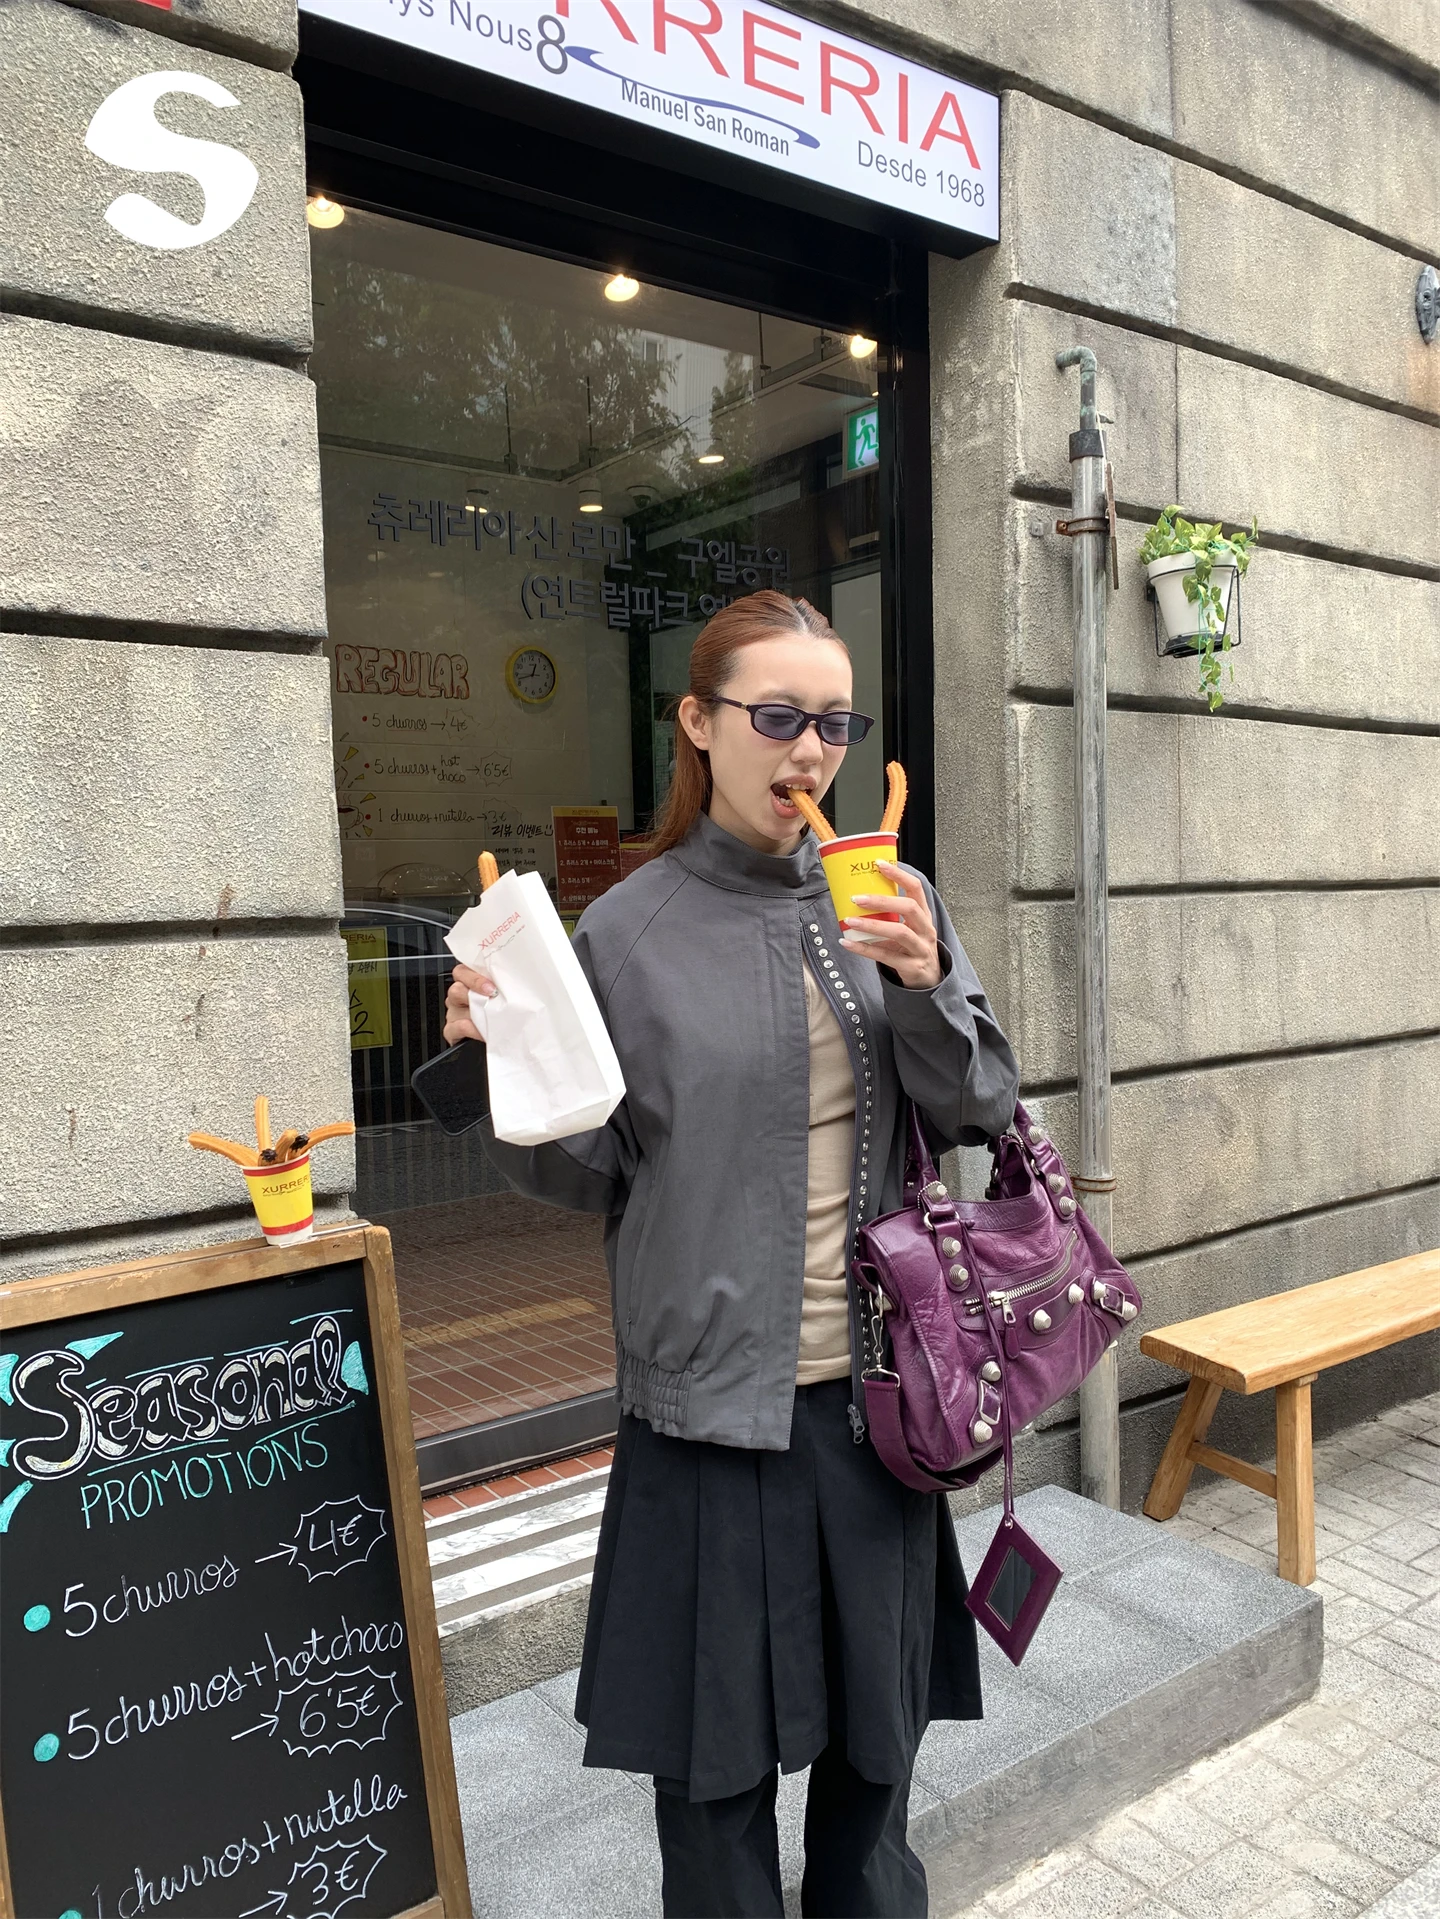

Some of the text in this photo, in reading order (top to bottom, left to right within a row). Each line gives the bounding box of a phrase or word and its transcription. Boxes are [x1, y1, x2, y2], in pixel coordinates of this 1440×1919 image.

[450, 1, 532, 51] Nous
[621, 79, 789, 156] Manuel San Roman
[858, 140, 985, 207] Desde 1968
[368, 493, 521, 555] 츄레리아
[525, 516, 563, 560] 산
[568, 521, 636, 571] 로만
[678, 536, 791, 588] 구엘공원
[335, 644, 470, 699] REGULAR
[372, 713, 381, 727] 5
[374, 759, 384, 774] 5
[491, 824, 543, 838] 리뷰 이벤트
[477, 911, 522, 950] XURRERIA
[12, 1315, 351, 1480] Seasonal
[80, 1424, 329, 1529] PROMOTIONS
[308, 1515, 362, 1556] 4€
[300, 1693, 381, 1739] 6'5€
[302, 1863, 362, 1905] 3€
